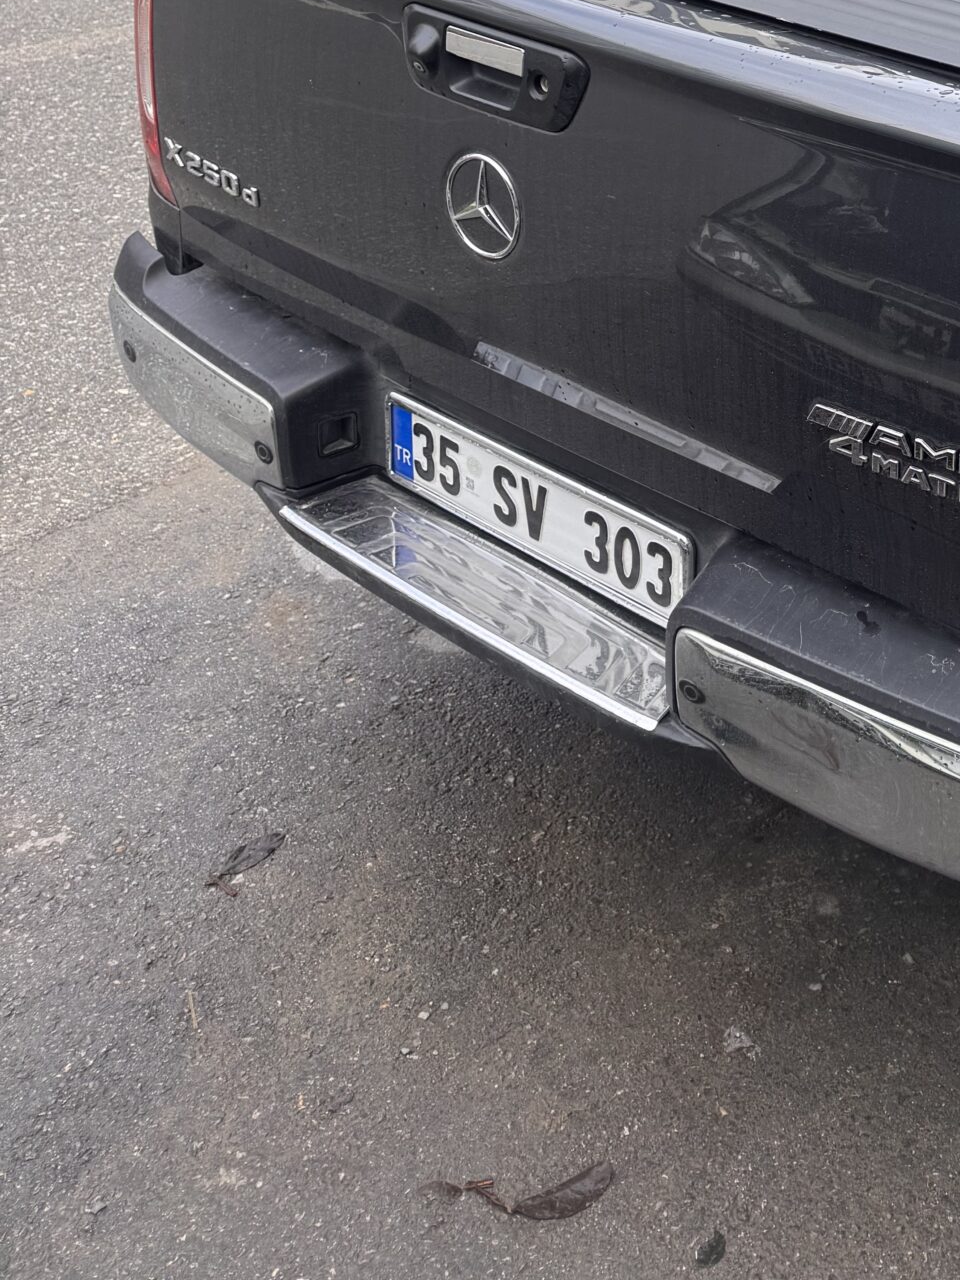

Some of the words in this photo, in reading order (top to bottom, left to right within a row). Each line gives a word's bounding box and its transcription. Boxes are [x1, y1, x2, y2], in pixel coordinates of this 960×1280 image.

[395, 443, 412, 467] TR
[413, 422, 461, 497] 35
[493, 464, 547, 542] SV
[584, 510, 673, 608] 303
